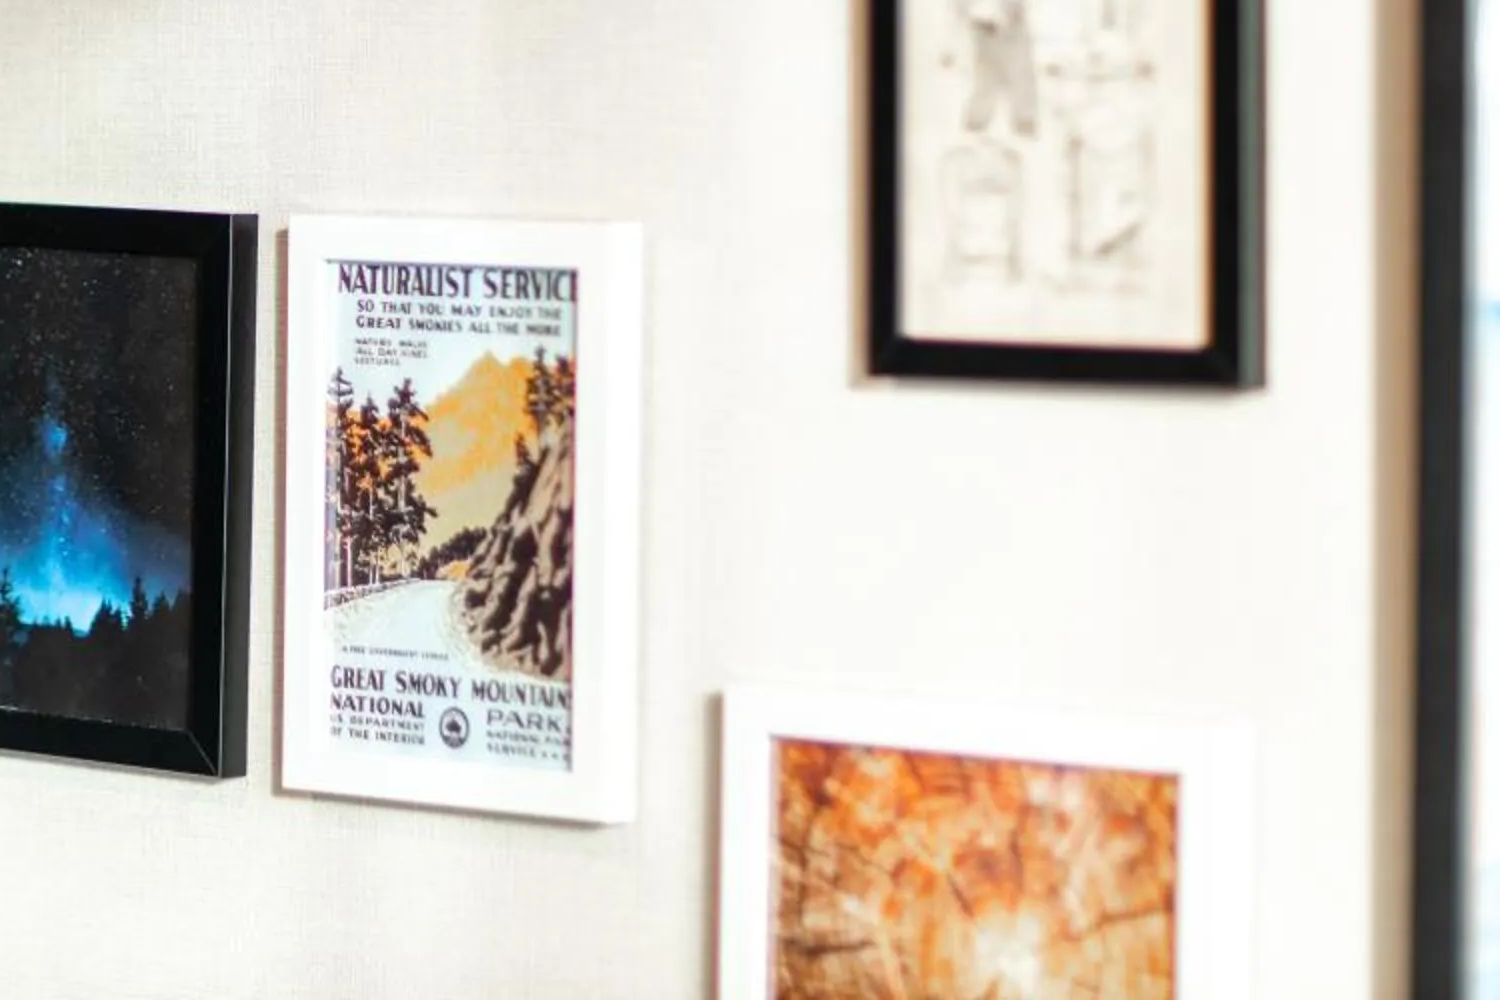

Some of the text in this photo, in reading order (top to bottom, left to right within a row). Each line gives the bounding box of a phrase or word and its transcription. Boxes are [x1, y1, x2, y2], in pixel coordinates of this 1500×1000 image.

[338, 263, 473, 299] NATURALIST
[357, 299, 561, 320] SO THAT YOU MAY ENJOY THE
[355, 315, 561, 337] GREAT SMOKIES ALL THE MORE
[330, 664, 387, 692] GREAT
[395, 669, 462, 699] SMOKY
[330, 692, 563, 732] NATIONAL PARK
[349, 715, 425, 730] DEPARTMENT
[348, 728, 369, 740] THE
[375, 731, 425, 745] INTERIOR
